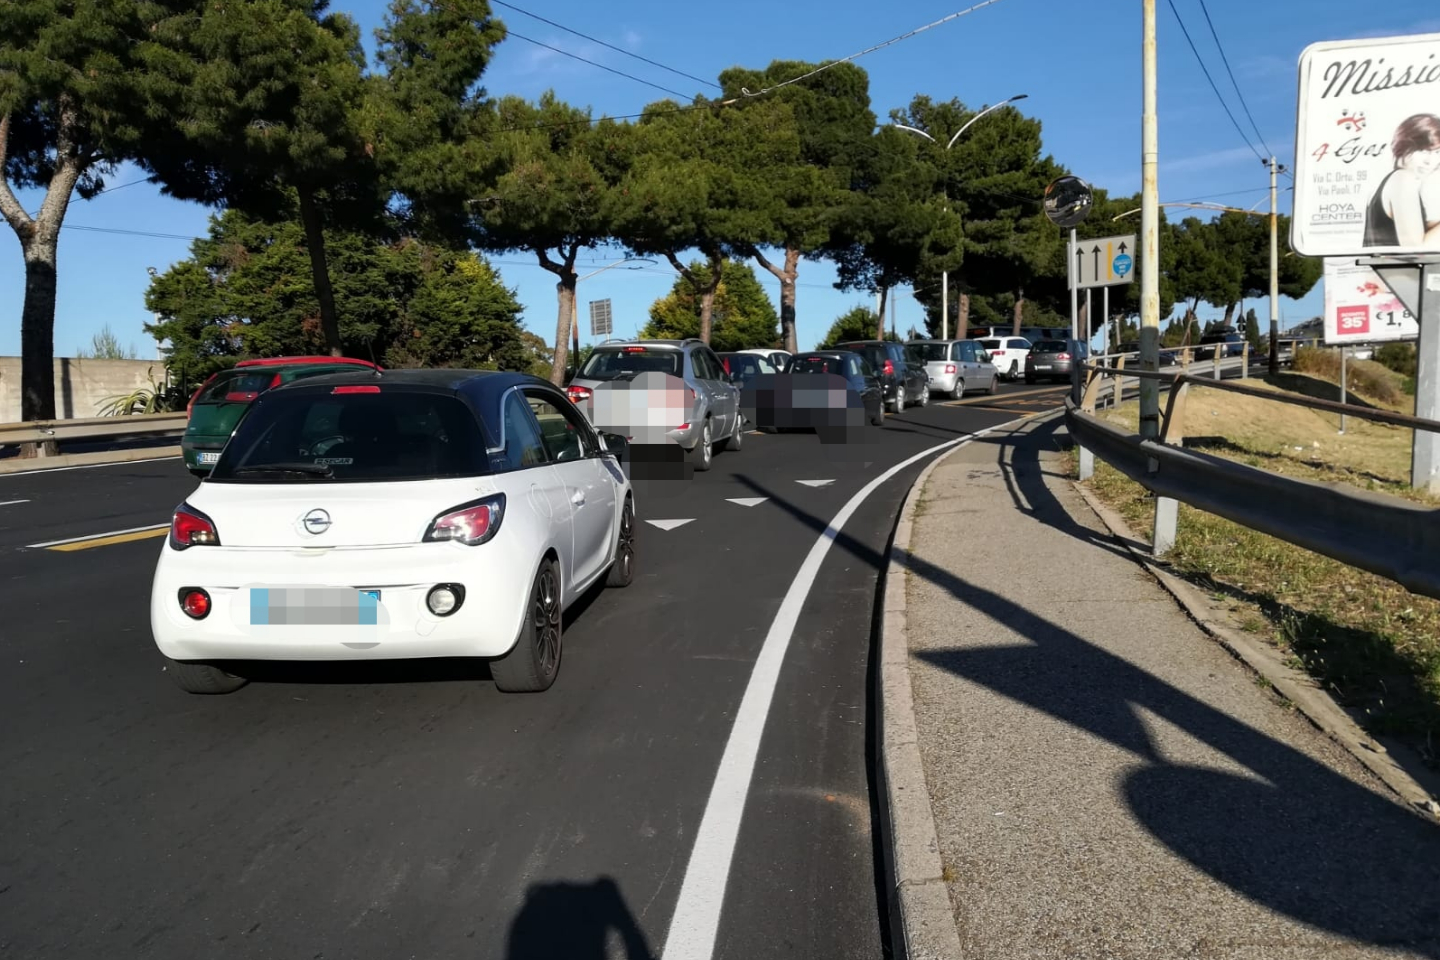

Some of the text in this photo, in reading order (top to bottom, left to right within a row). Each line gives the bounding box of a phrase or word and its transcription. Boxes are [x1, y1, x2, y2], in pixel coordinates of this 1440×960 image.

[1312, 136, 1387, 164] 4 Eyes
[1312, 173, 1324, 183] Via
[1318, 185, 1330, 196] Via
[1319, 203, 1355, 213] HOYA
[1312, 212, 1362, 221] CENTER
